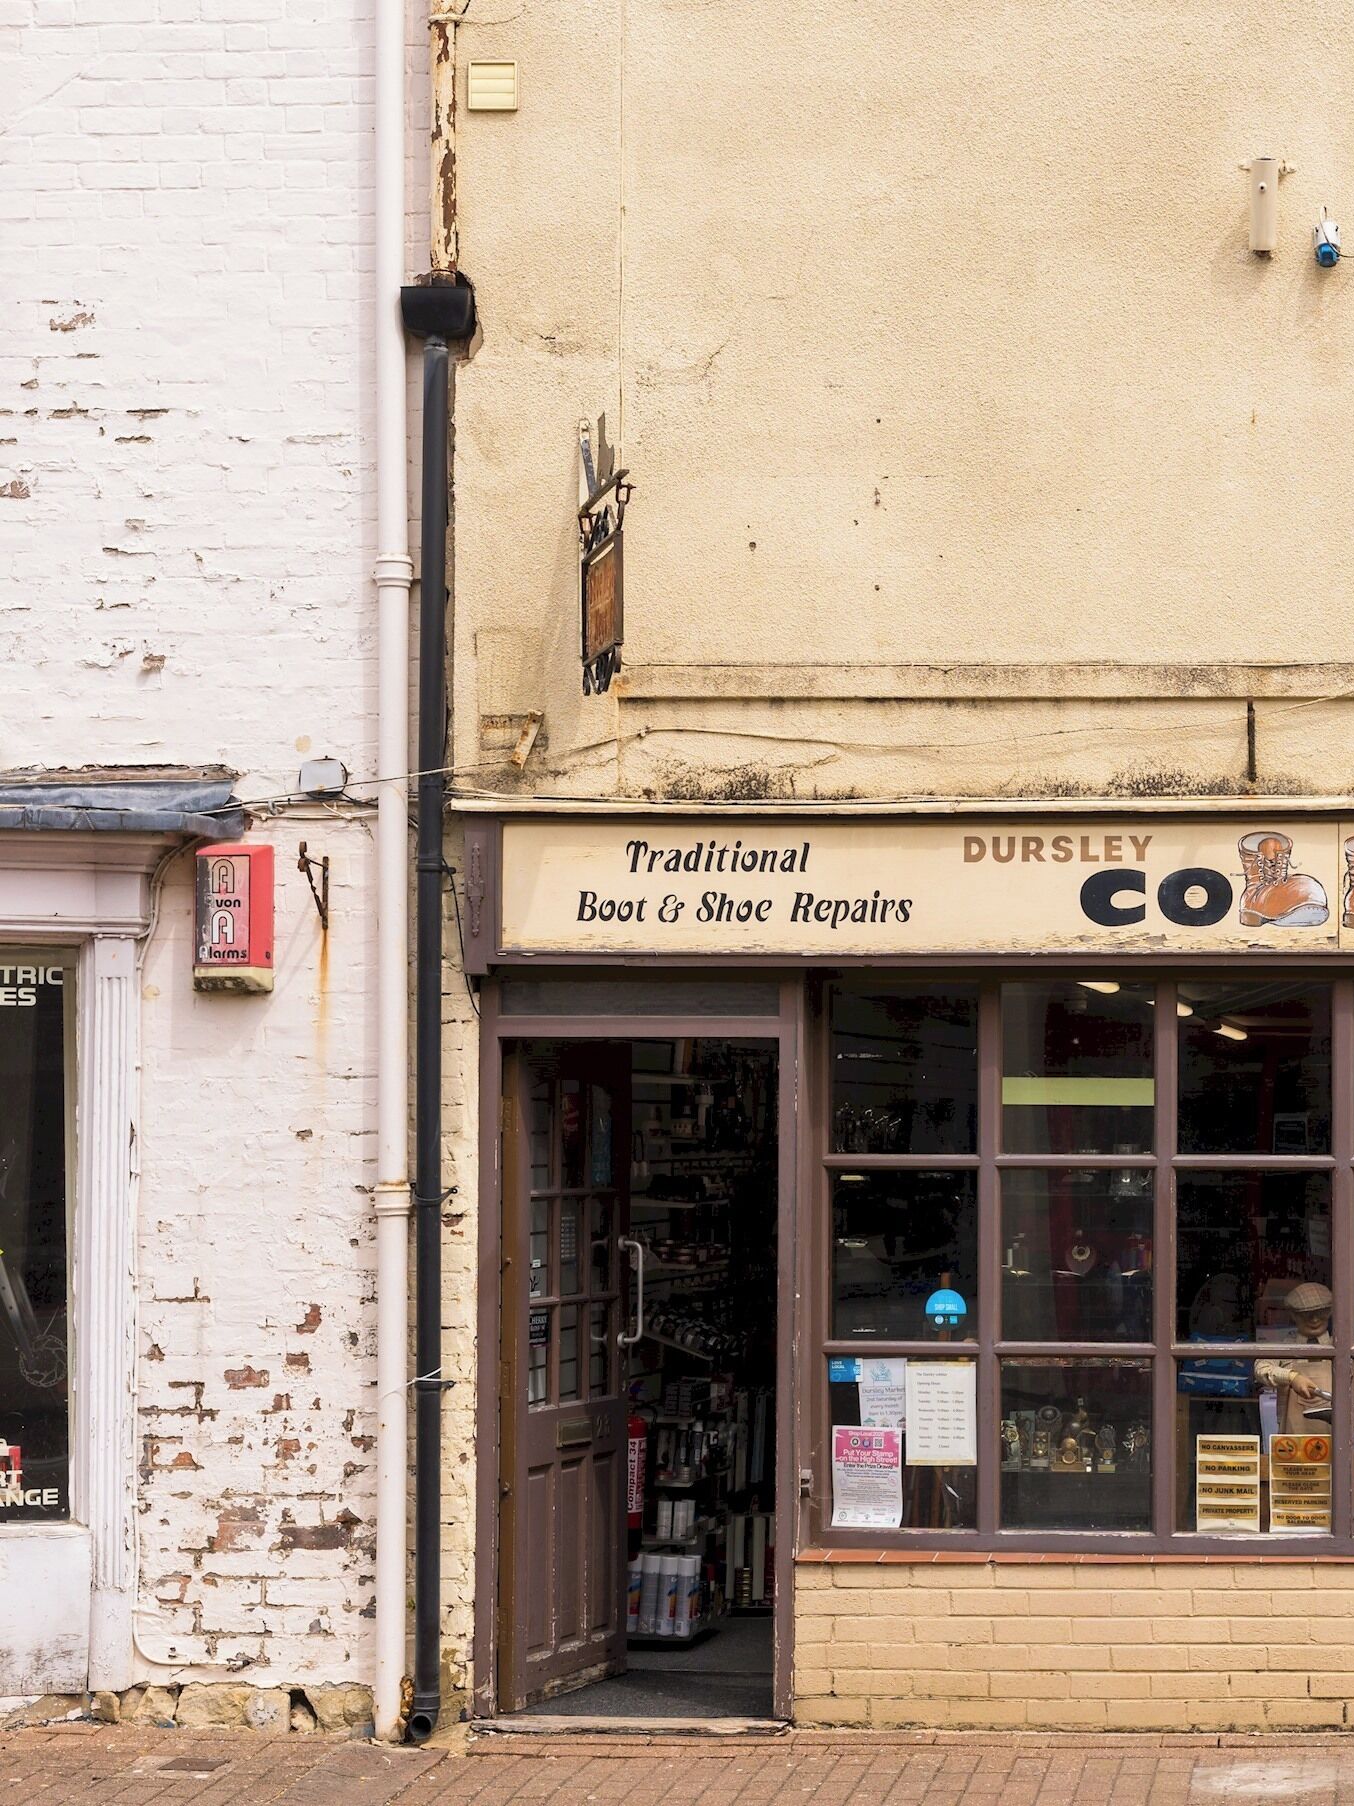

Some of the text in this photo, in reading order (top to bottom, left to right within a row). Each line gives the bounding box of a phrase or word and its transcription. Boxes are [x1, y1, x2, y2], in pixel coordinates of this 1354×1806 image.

[625, 840, 810, 873] Traditional
[963, 835, 1153, 863] DURSLEY
[576, 889, 914, 930] Boot & Shoe Repairs
[0, 965, 64, 986] TRIC
[0, 987, 37, 1007] ES
[0, 1488, 59, 1507] NGE
[627, 1459, 637, 1511] Compact
